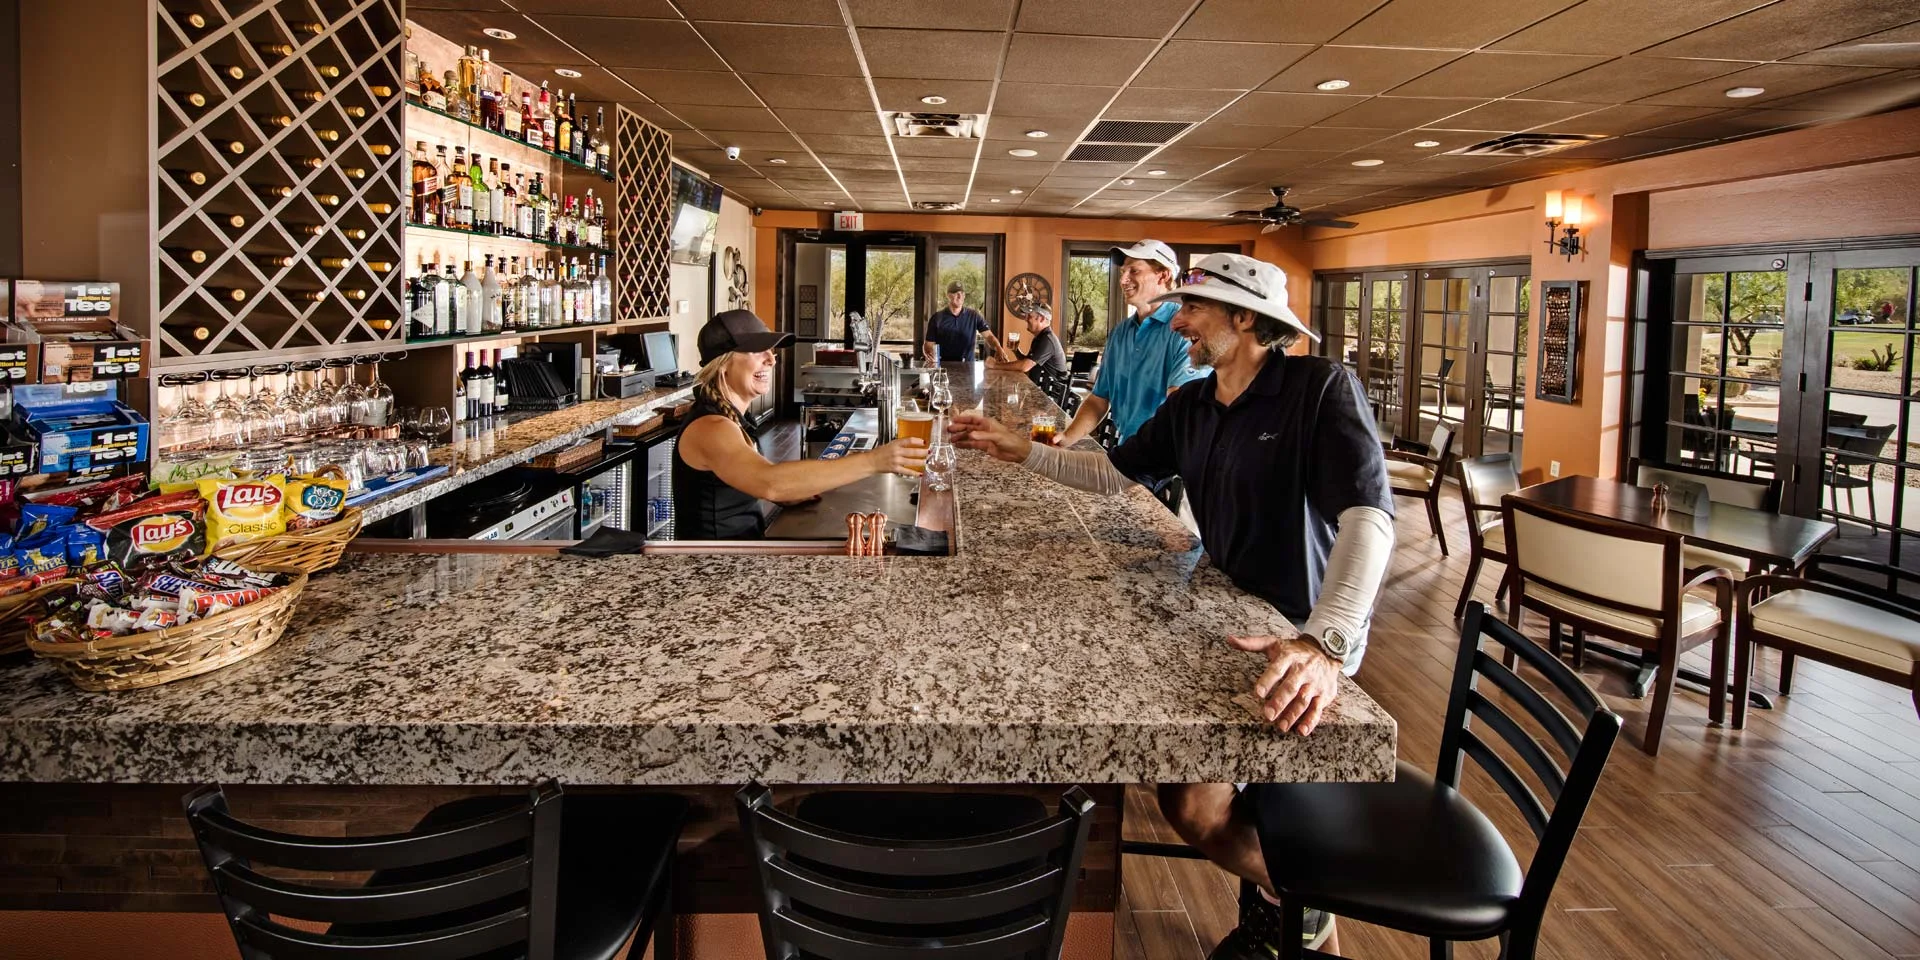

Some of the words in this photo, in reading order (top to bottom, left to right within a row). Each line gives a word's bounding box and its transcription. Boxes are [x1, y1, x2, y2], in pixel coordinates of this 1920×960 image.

[840, 215, 857, 229] EXIT
[71, 284, 111, 296] 1st
[64, 299, 112, 311] Tee
[0, 350, 26, 360] st
[100, 346, 140, 358] 1st
[98, 431, 138, 445] 1st
[223, 484, 277, 509] Lay's
[138, 519, 188, 546] Lay's
[228, 519, 278, 535] Classic
